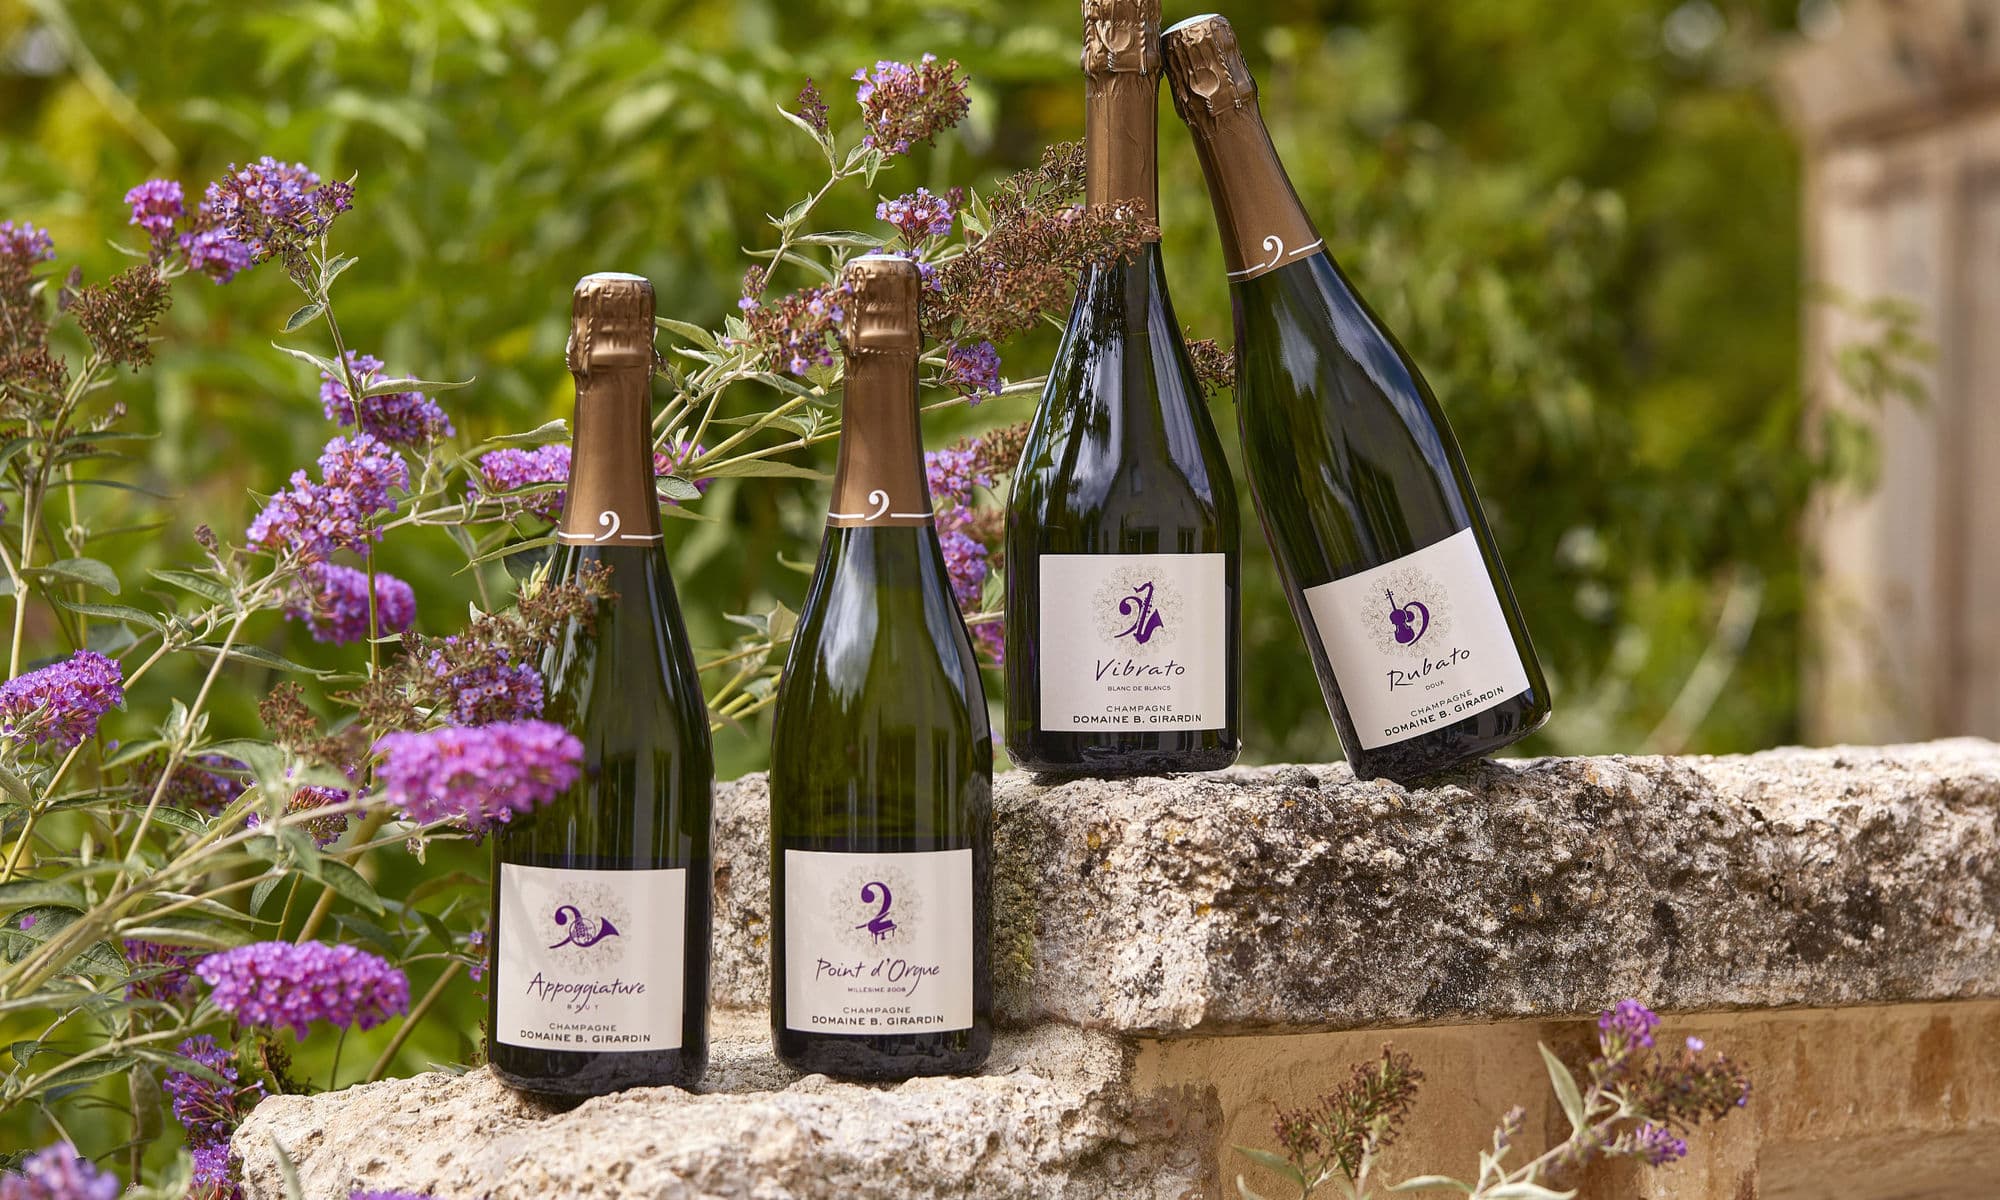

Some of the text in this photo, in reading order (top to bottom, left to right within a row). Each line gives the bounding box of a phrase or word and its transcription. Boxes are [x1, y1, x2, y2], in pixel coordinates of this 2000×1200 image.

[1095, 658, 1186, 681] Vibrato
[1386, 647, 1471, 692] Rubato
[1425, 680, 1445, 691] DOUX
[1106, 704, 1172, 713] CHAMPAGNE
[1410, 689, 1473, 717] CHAMPAGNE
[1384, 685, 1505, 737] DOMAINE B. GIRARDIN
[1072, 714, 1202, 724] DOMAINE B. GIRARDIN
[815, 957, 940, 998] Point d'Orgue
[526, 971, 646, 1015] Appoggiature
[842, 1006, 912, 1014] CHAMPAGNE
[549, 1022, 617, 1032] CHAMPAGNE
[811, 1015, 944, 1026] DOMAINE B. GIRARDIN
[520, 1030, 651, 1043] DOMAINE B. GIRARDIN
